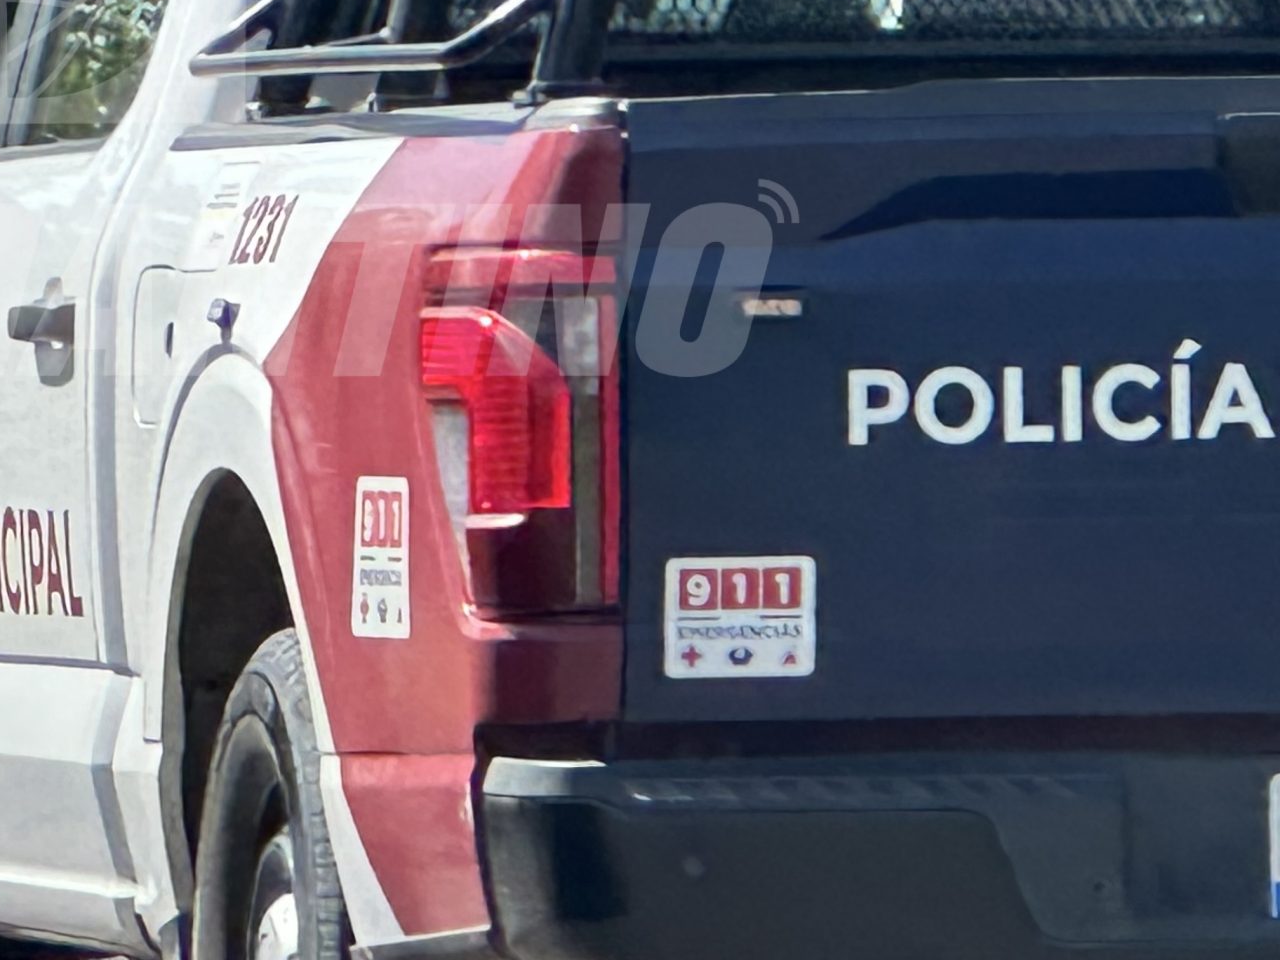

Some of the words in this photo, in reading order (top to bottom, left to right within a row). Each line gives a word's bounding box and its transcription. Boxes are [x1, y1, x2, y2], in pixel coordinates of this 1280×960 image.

[227, 193, 300, 265] 1231
[848, 339, 1276, 445] POLICÍA
[686, 572, 791, 606] 911
